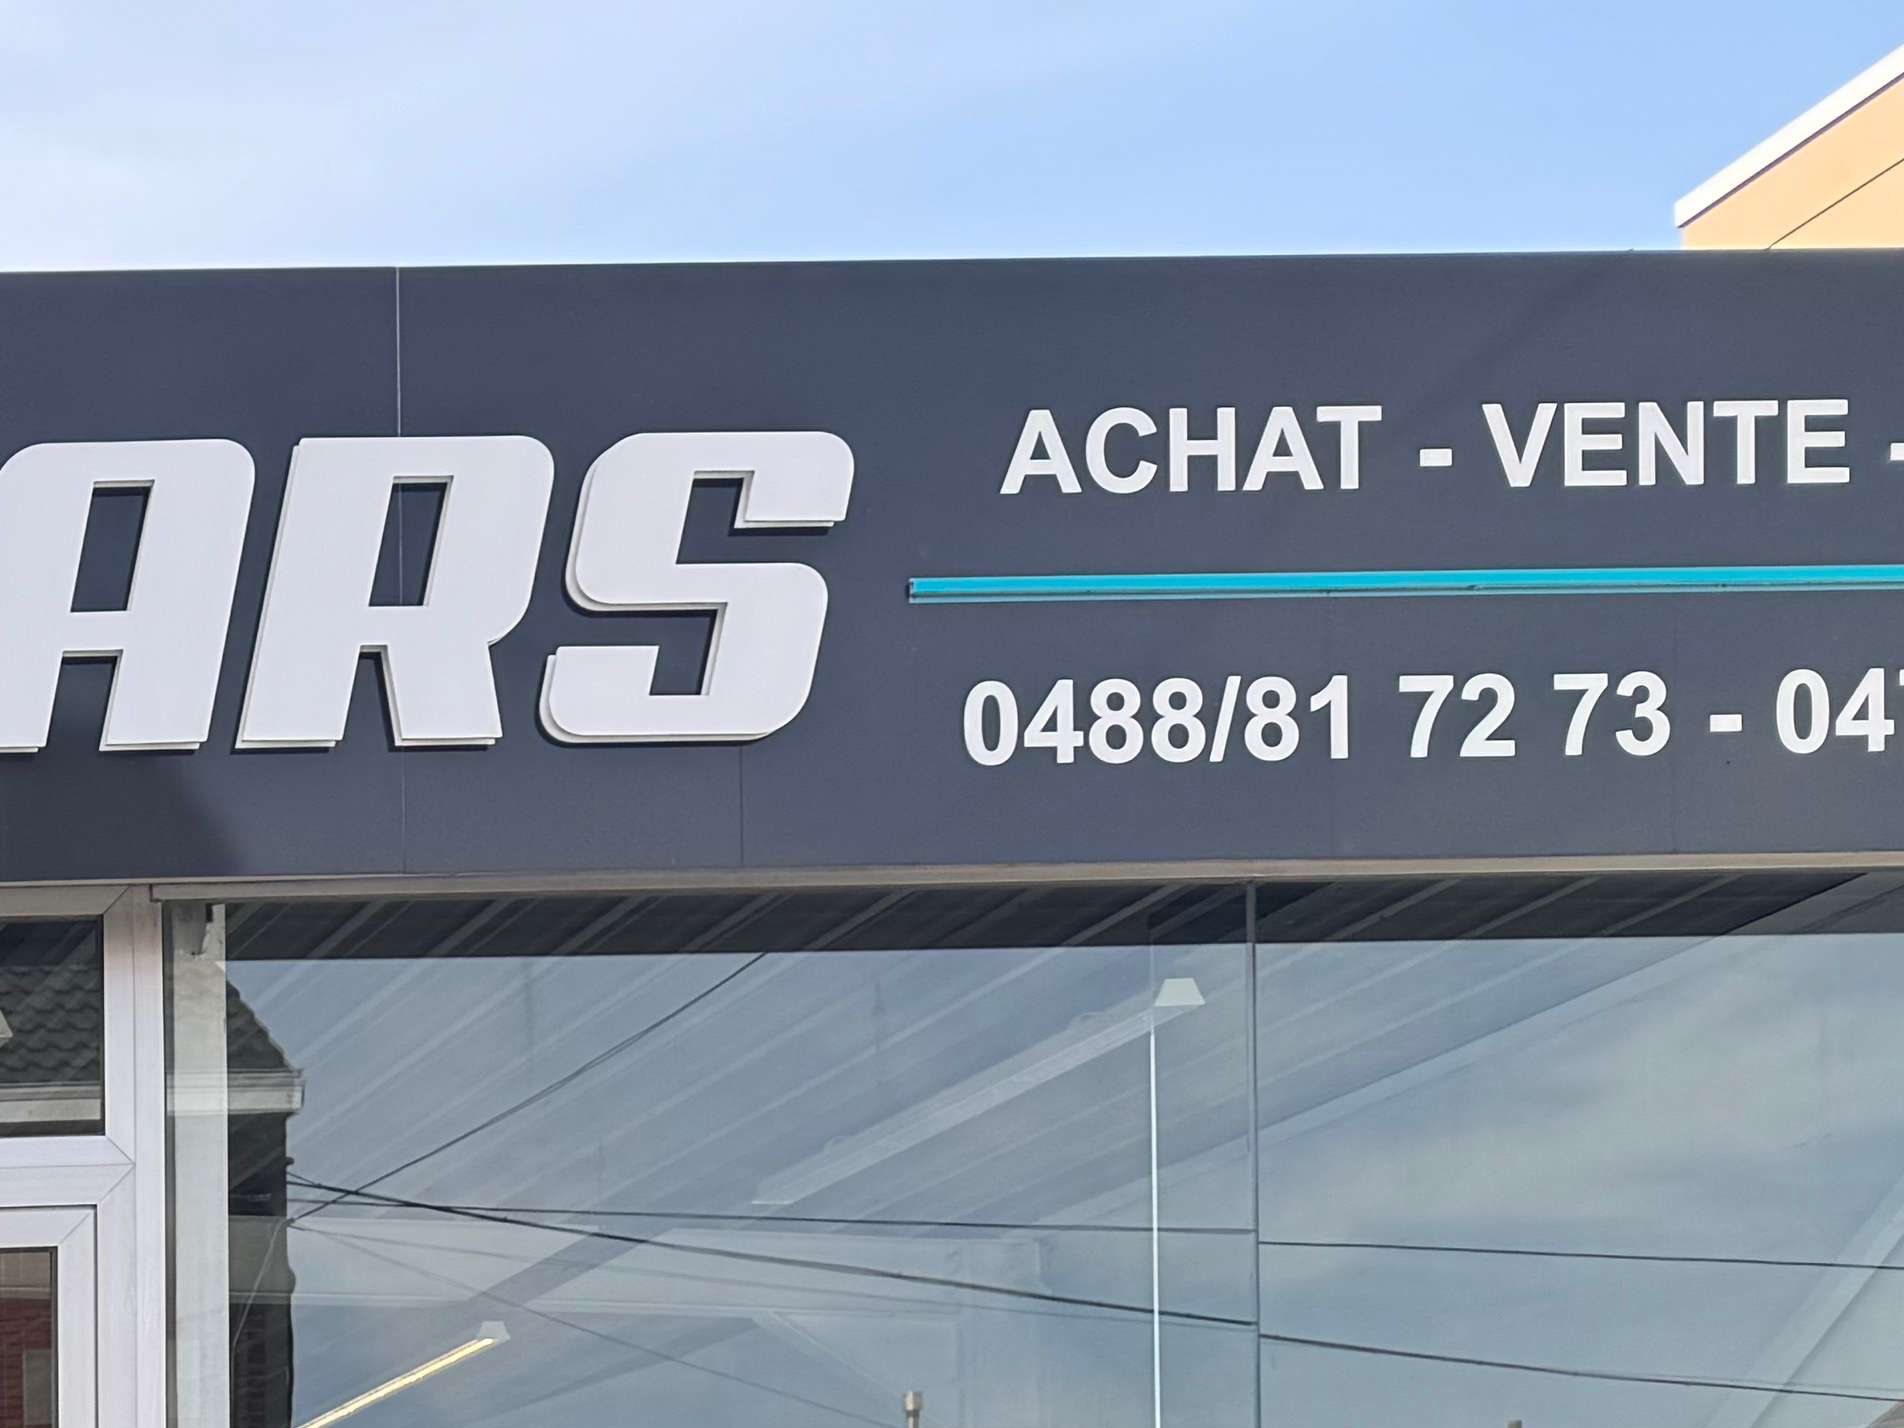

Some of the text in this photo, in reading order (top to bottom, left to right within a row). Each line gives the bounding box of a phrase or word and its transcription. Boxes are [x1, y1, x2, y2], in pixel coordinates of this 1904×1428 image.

[999, 398, 1850, 495] ACHAT - VENTE
[962, 667, 1904, 765] 0488/81 72 73 - 04
